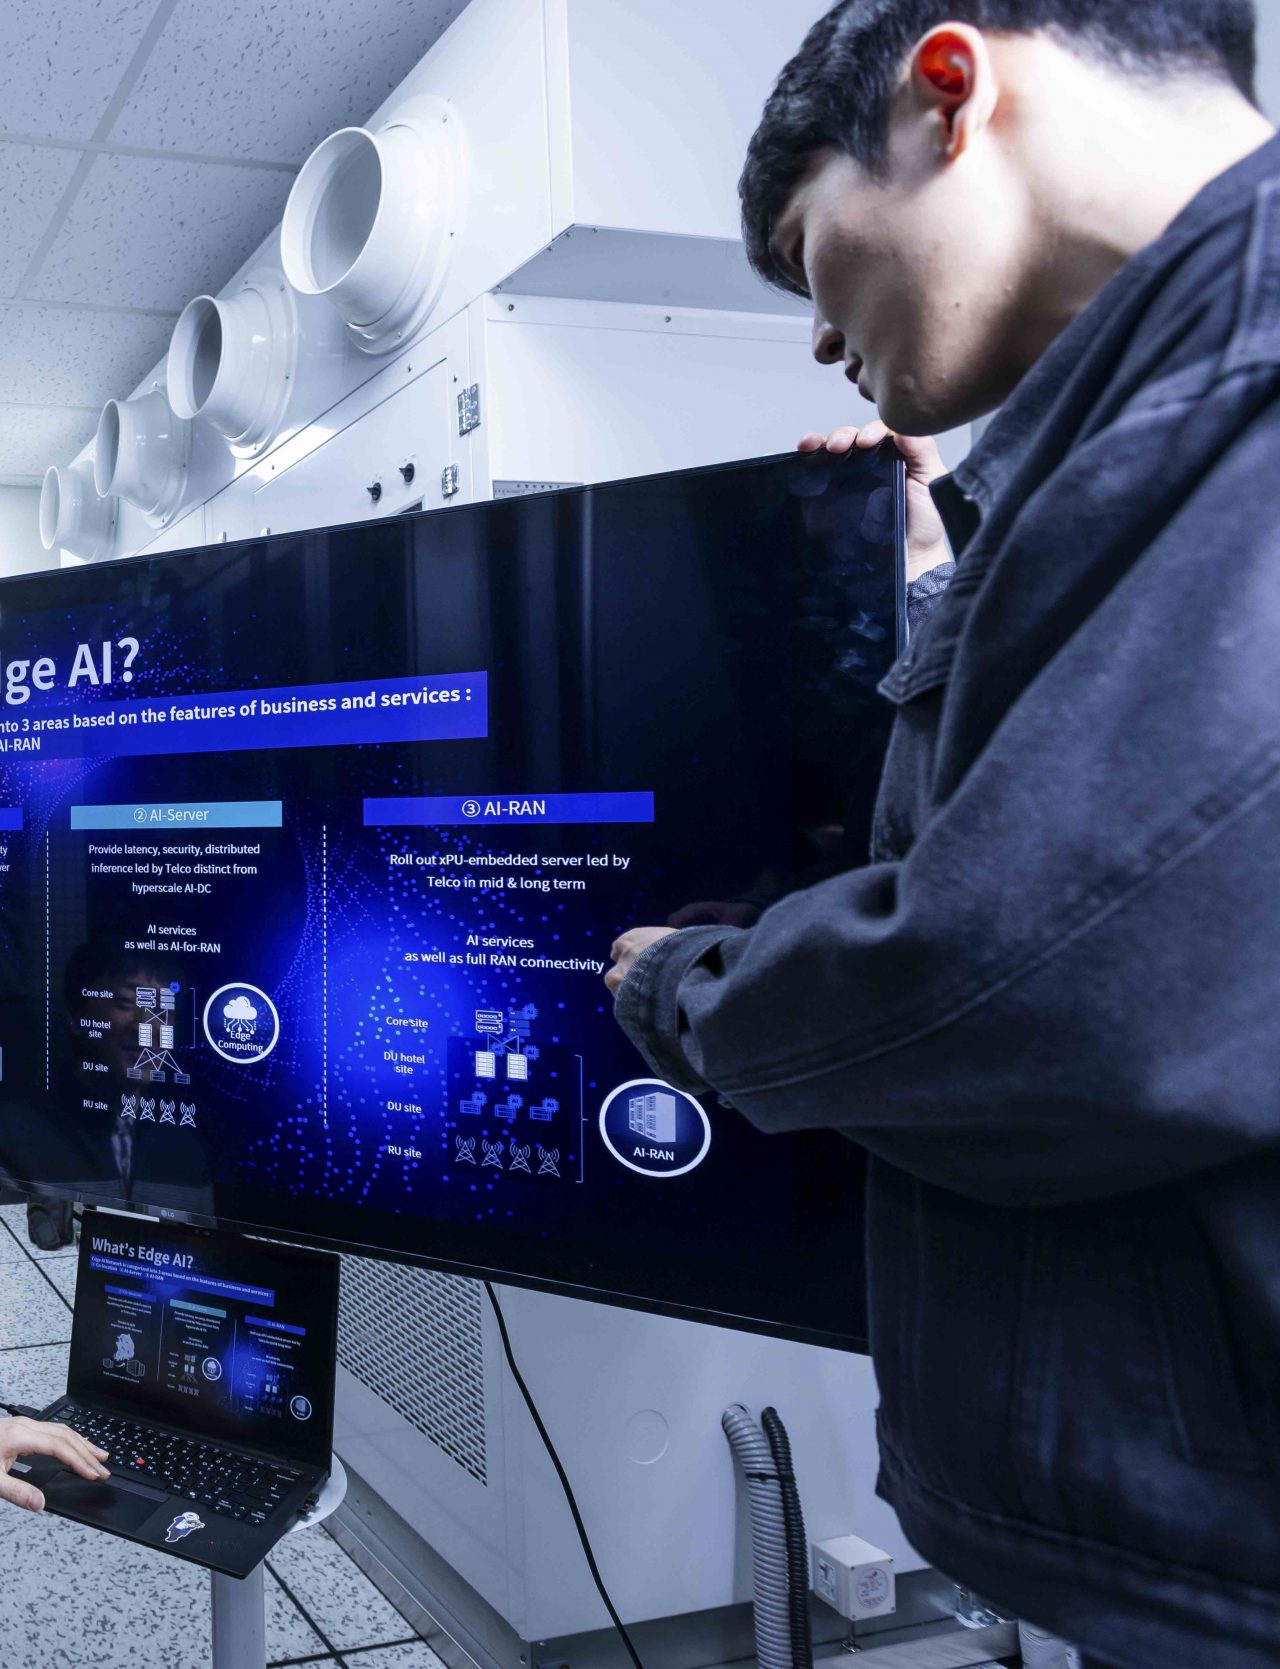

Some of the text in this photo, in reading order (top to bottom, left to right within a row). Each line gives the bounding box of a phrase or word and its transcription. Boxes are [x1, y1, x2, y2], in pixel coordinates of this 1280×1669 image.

[68, 637, 140, 687] AI?
[22, 719, 29, 731] 3
[33, 717, 69, 731] areas
[73, 711, 115, 728] based
[119, 713, 137, 724] on
[141, 708, 166, 723] the
[170, 703, 236, 721] features
[239, 700, 257, 716] of
[260, 697, 336, 715] business
[341, 692, 376, 709] and
[380, 687, 460, 707] services
[484, 801, 545, 816] AI-RAN
[150, 809, 209, 821] AI-Server
[89, 844, 260, 857] Provide latency, security, distributed
[390, 854, 630, 869] Roll out xPU-embedded server led by
[91, 863, 257, 876] inference led by Telco distinct from
[132, 882, 211, 894] hyperscale AI-DC
[427, 876, 585, 892] Telco in mid & long term
[147, 925, 196, 936] AI services
[125, 940, 221, 953] as well as AI-for-RAN
[467, 935, 534, 948] AI services
[405, 951, 604, 974] as well as full RAN connectivity
[82, 989, 113, 999] Core site
[80, 1019, 111, 1029] DU hotel
[386, 1016, 428, 1028] Core site
[89, 1030, 102, 1038] site
[230, 1030, 251, 1041] Edge
[218, 1040, 263, 1053] Computing
[384, 1052, 425, 1064] DU hotel
[83, 1062, 108, 1072] DU site
[395, 1064, 413, 1075] site
[83, 1100, 108, 1110] RU site
[387, 1102, 422, 1114] DU site
[387, 1146, 422, 1158] RU site
[633, 1147, 674, 1161] AI-RAN
[138, 1246, 169, 1266] Edge
[173, 1253, 193, 1268] AI?
